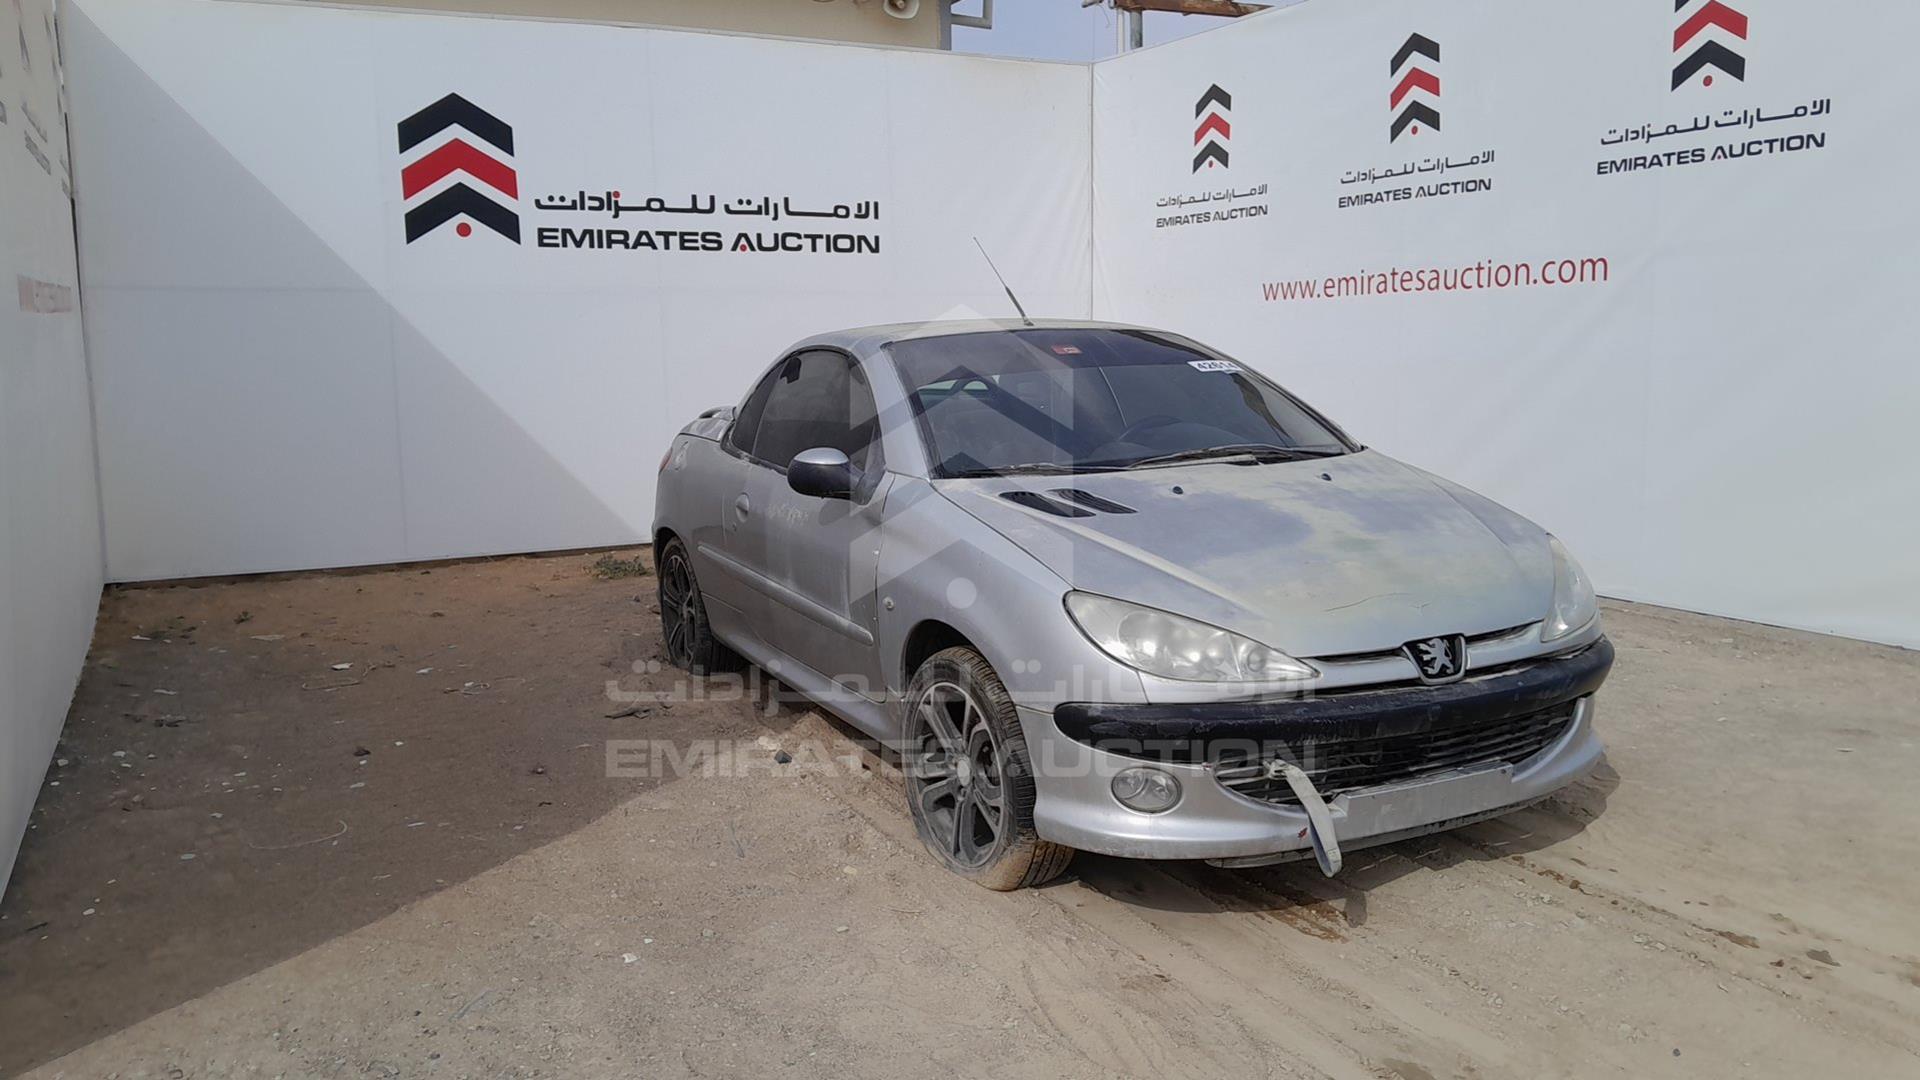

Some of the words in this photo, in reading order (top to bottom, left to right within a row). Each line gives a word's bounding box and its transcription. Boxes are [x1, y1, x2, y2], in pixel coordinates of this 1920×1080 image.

[1713, 98, 1831, 130] الامارات
[1600, 115, 1710, 146] للمزادات
[1417, 150, 1495, 174] الامارات
[1596, 147, 1706, 175] EMIRATES
[1710, 132, 1826, 162] AUCTION
[1340, 162, 1415, 184] للمزادات
[534, 190, 716, 219] للمزادات
[1156, 192, 1211, 208] للمزادات
[1212, 184, 1268, 203] الامارات
[1338, 187, 1412, 208] EMIRATES
[1415, 178, 1492, 198] AUCTION
[724, 197, 880, 221] الامارات
[1156, 212, 1211, 228] EMIRATES
[1212, 204, 1268, 222] AUCTION
[536, 227, 723, 252] EMIRATES
[731, 232, 880, 254] AUCTION
[1262, 256, 1609, 301] www.emiratesauction.com
